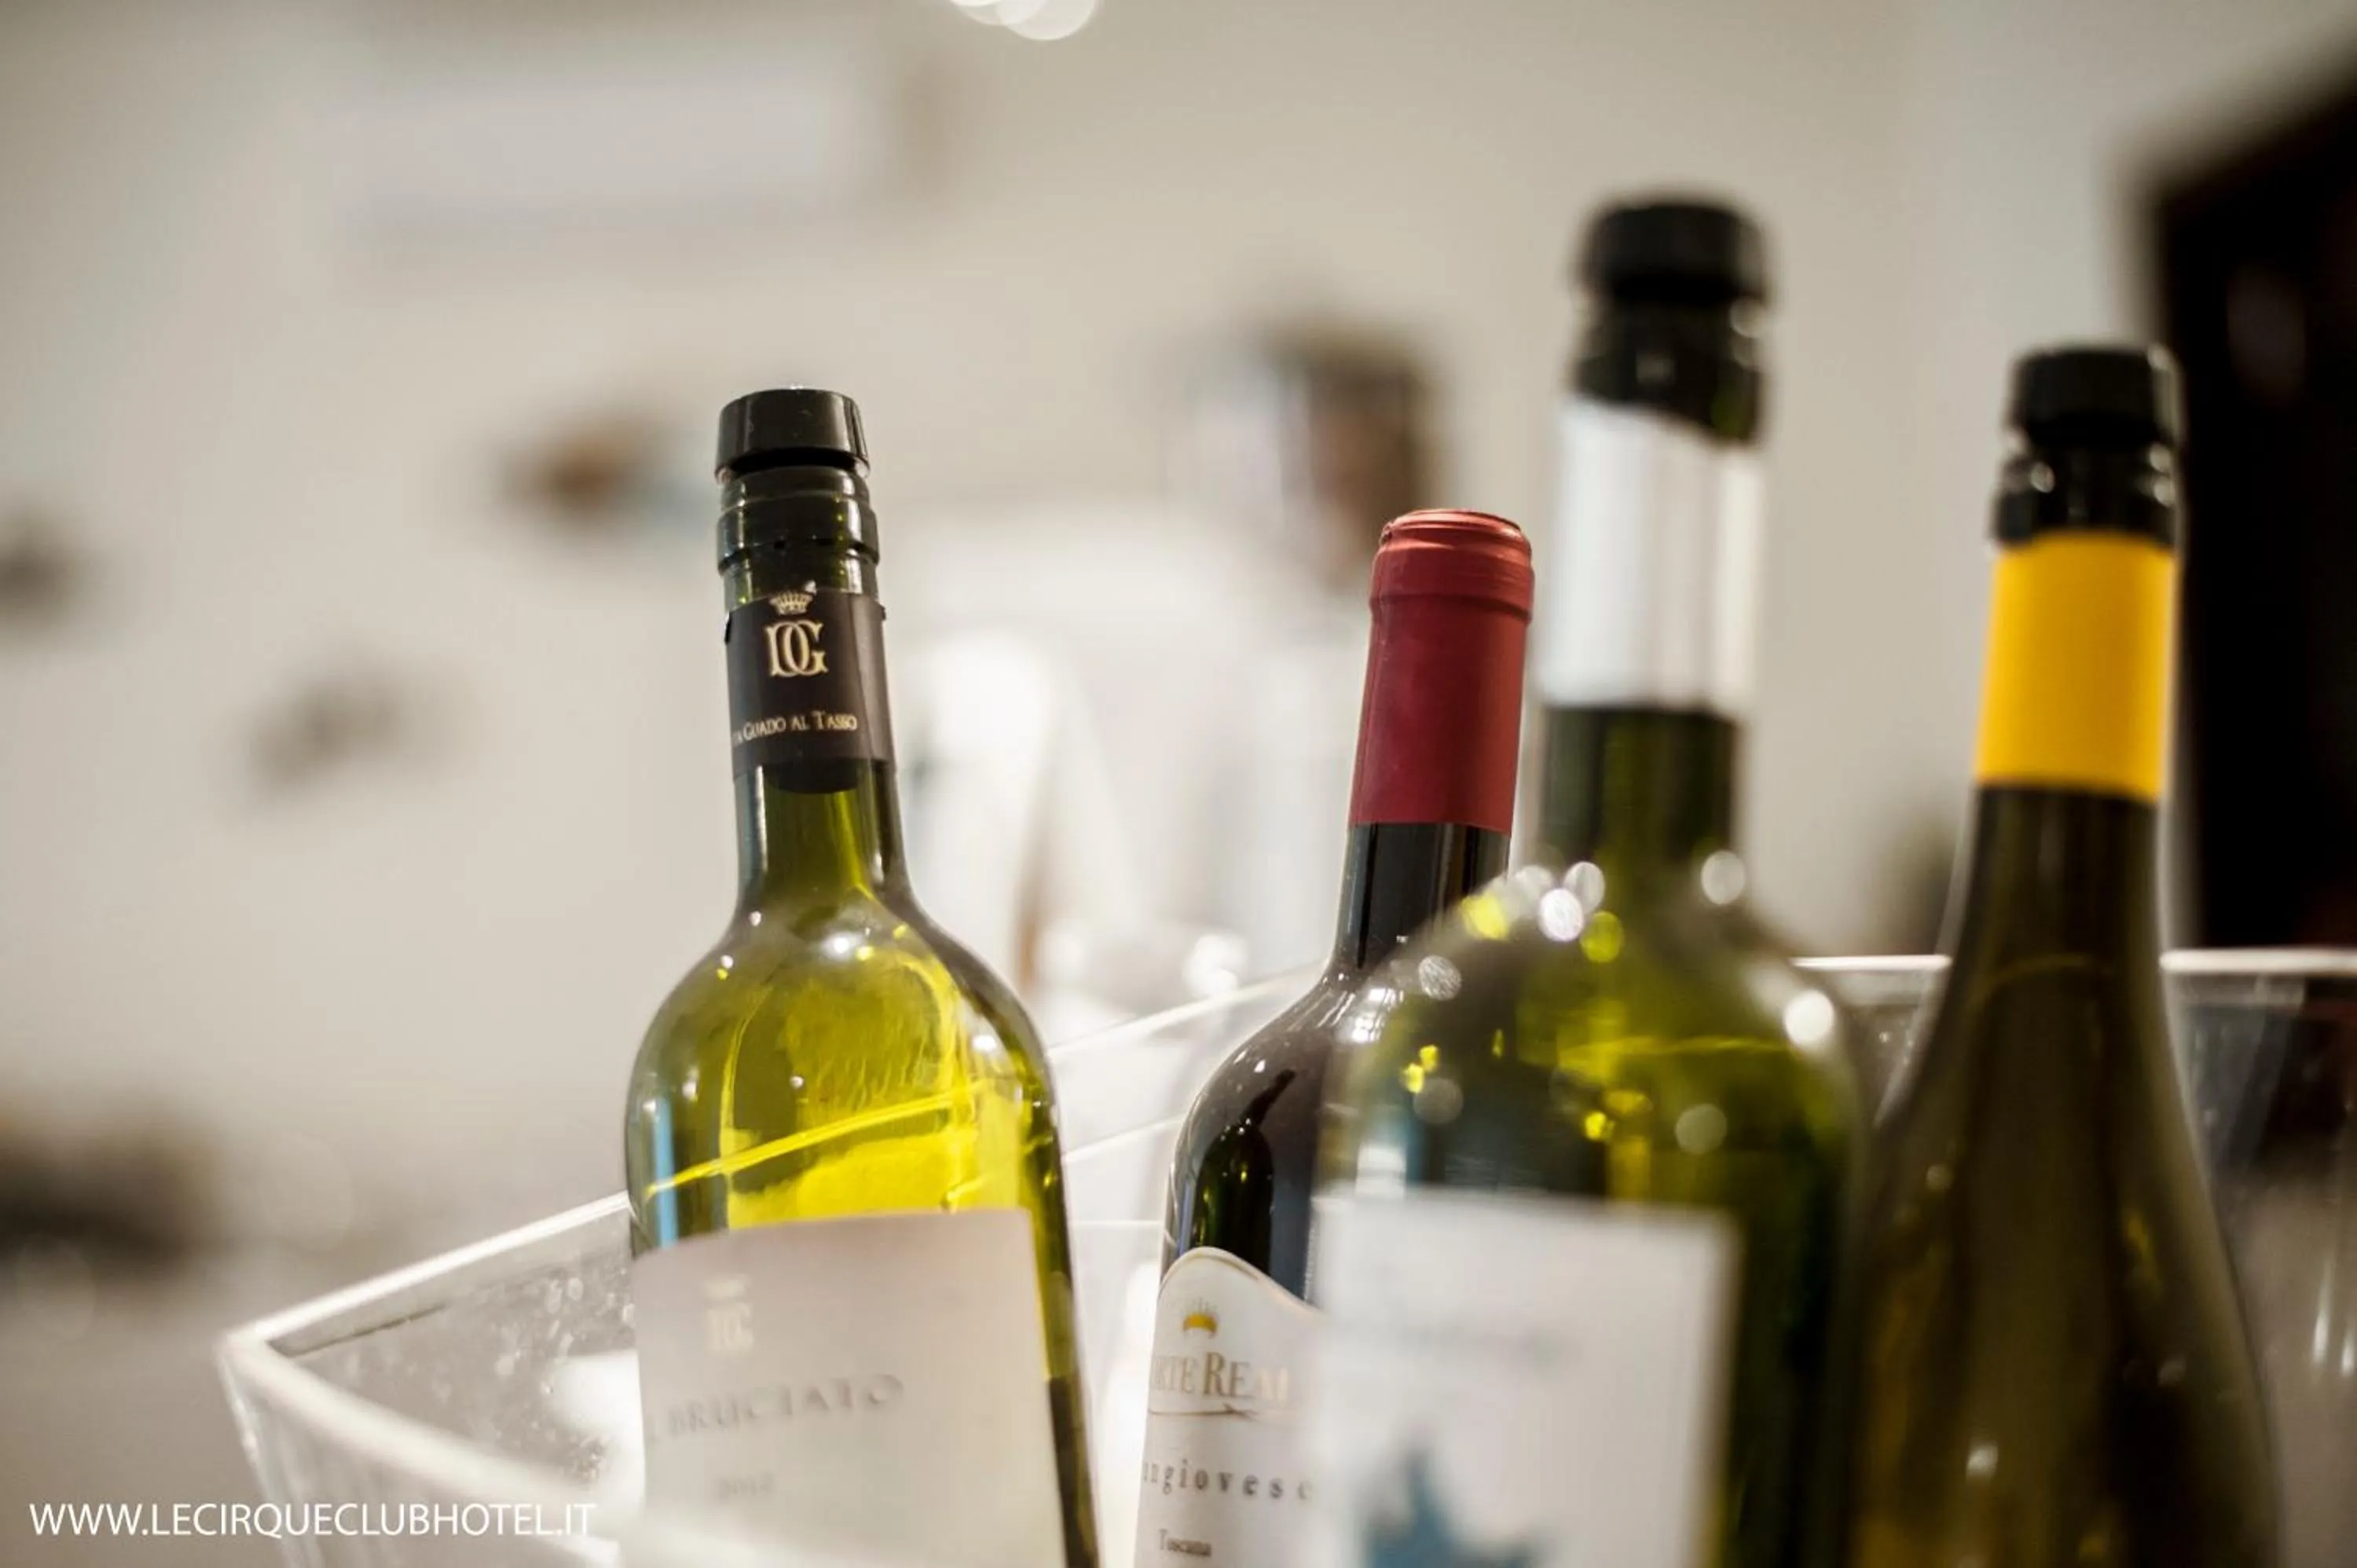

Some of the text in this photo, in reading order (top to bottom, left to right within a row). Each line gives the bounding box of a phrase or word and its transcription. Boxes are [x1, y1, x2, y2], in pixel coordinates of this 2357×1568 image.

[743, 716, 786, 741] GUADO
[790, 715, 810, 731] AL
[812, 710, 858, 731] TASSO
